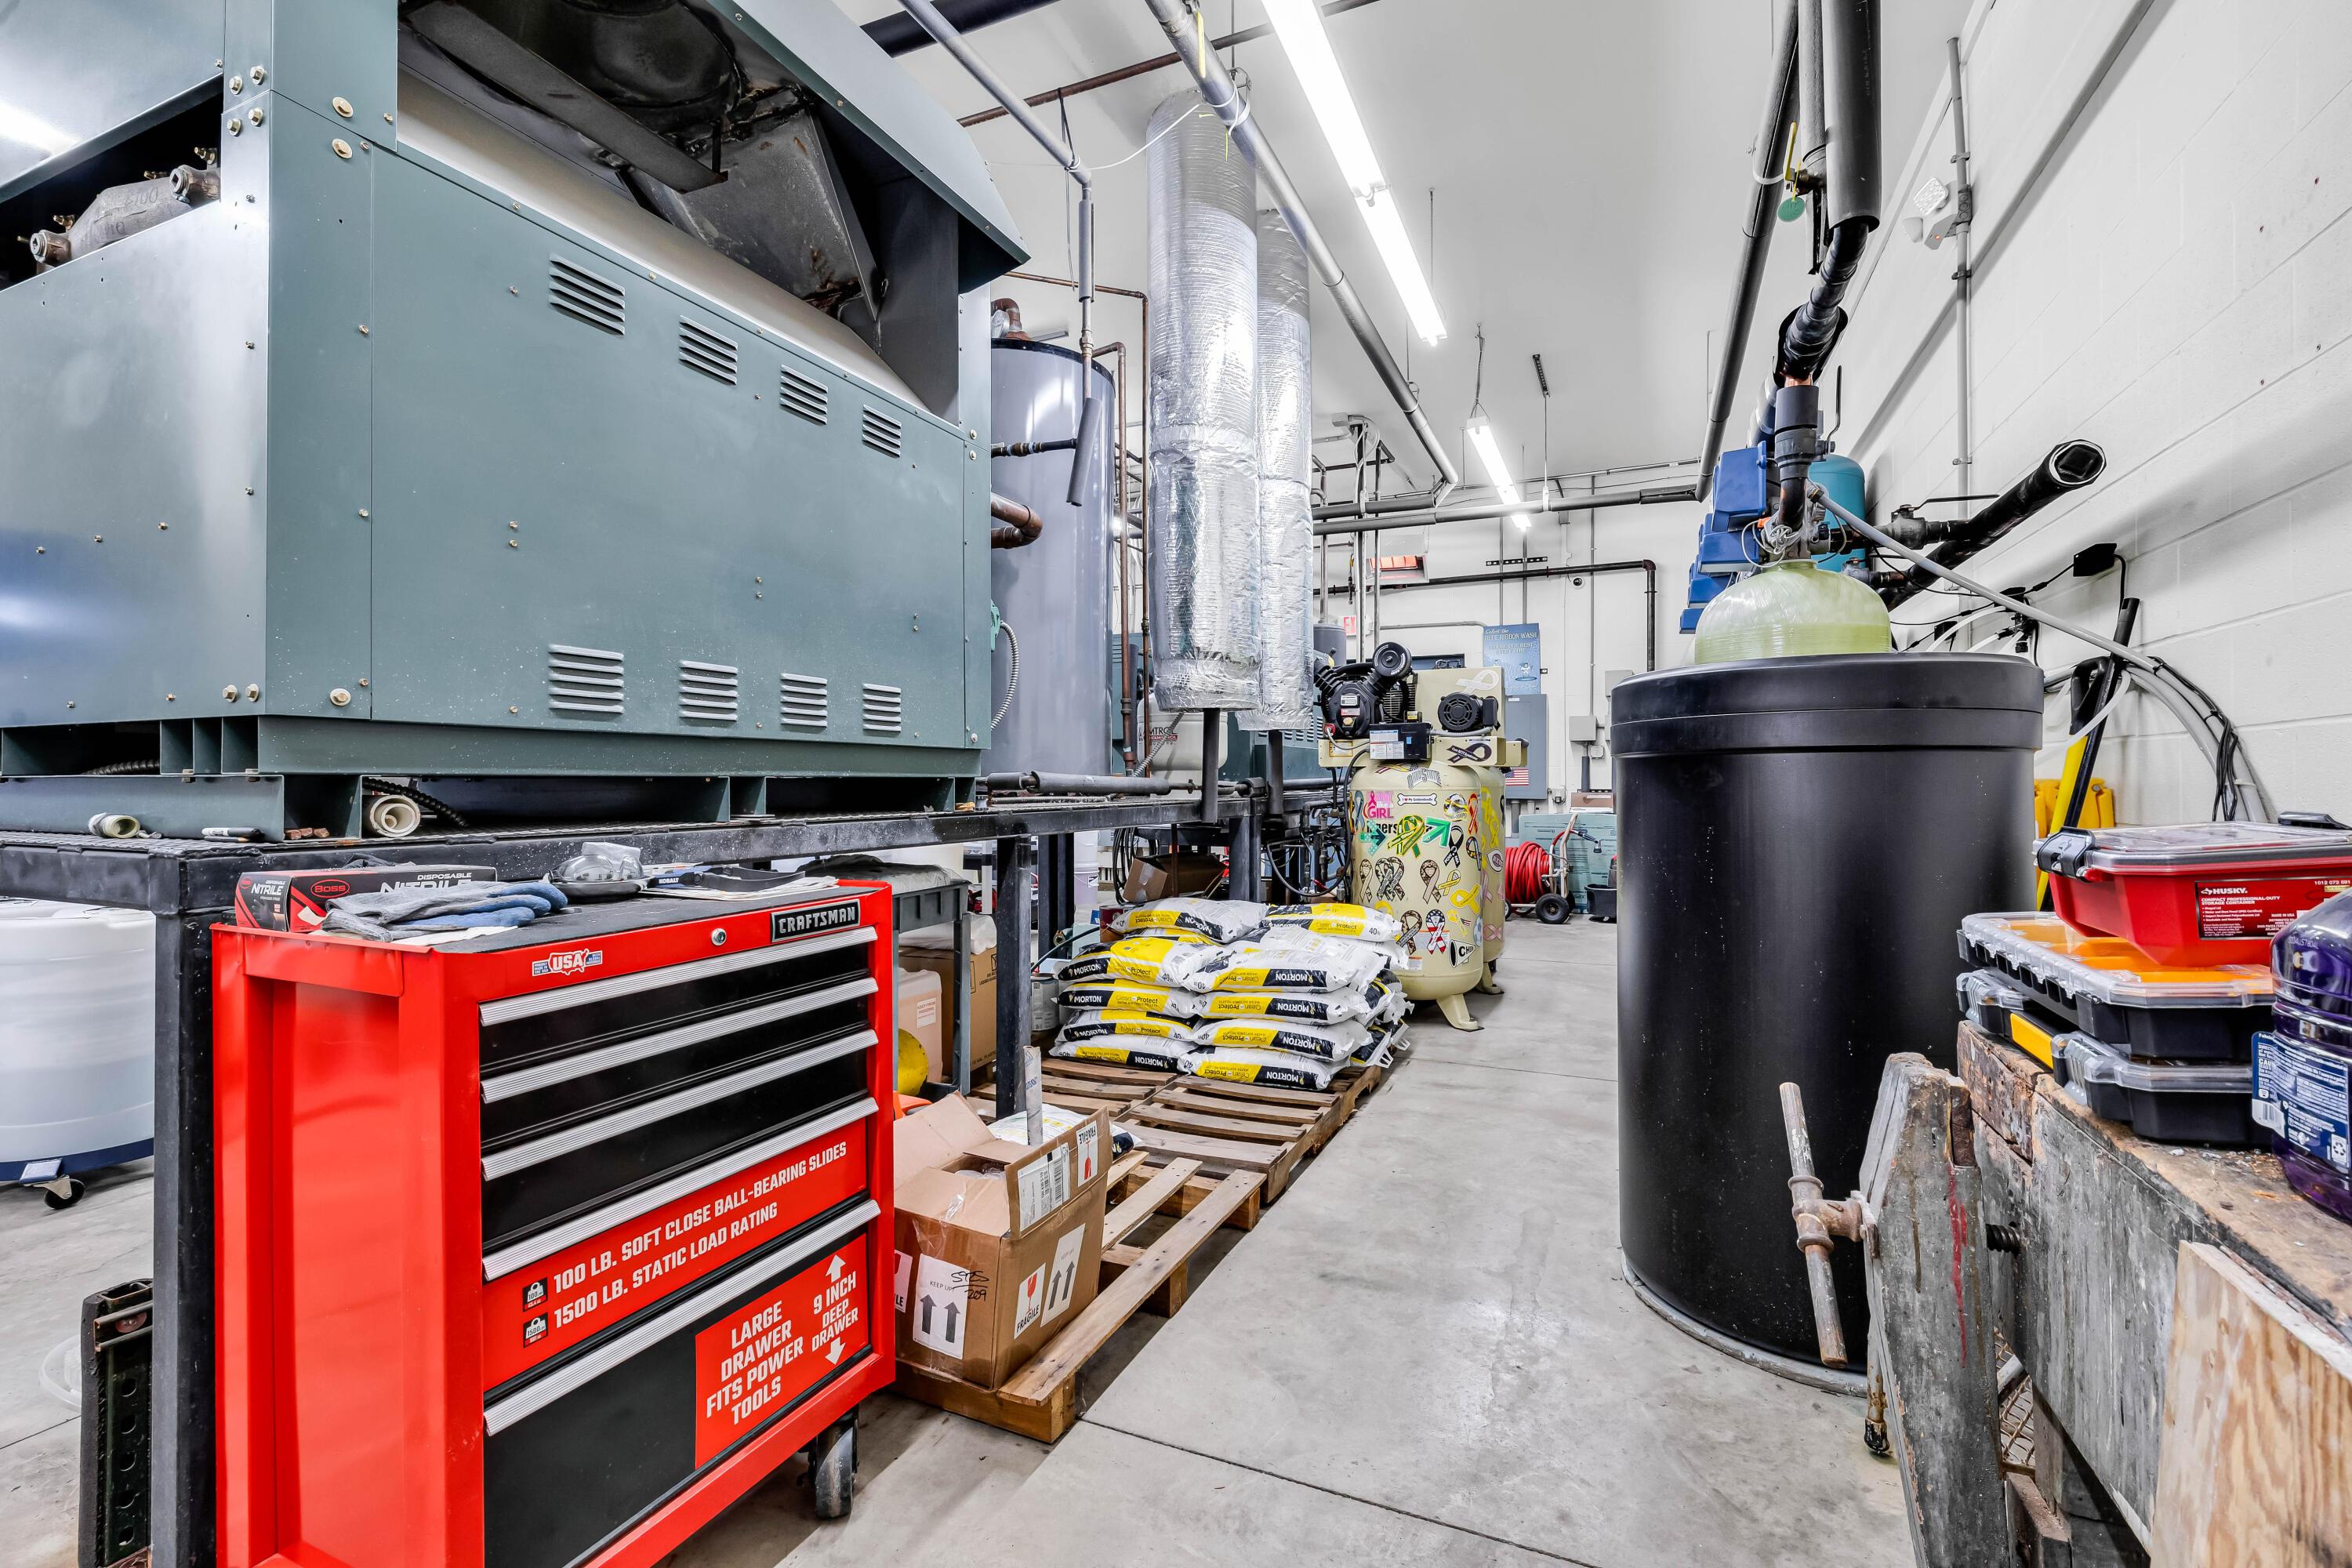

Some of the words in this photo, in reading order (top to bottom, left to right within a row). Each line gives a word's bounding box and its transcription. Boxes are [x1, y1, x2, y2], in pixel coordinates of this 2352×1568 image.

[1367, 805, 1394, 819] GIRL
[417, 873, 472, 881] DISPOSABLE
[251, 883, 284, 895] NITRILE
[779, 906, 855, 934] CRAFTSMAN
[553, 953, 584, 971] USA
[1073, 964, 1101, 976] MORTON
[1276, 972, 1308, 981] MORTON
[1073, 995, 1102, 1004] MORTON
[1277, 1003, 1309, 1013] MORTON
[1283, 1036, 1316, 1051] MORTON
[1134, 1056, 1163, 1067] MORTON
[1266, 1071, 1299, 1083] MORTON
[1078, 1125, 1096, 1145] FRAGILE
[554, 1262, 586, 1294] 100
[590, 1250, 617, 1277] LB.
[621, 1226, 662, 1262] SOFT
[665, 1204, 711, 1240] CLOSE
[714, 1160, 806, 1218] BALL-BEARING
[808, 1141, 847, 1172] SLIDES
[554, 1290, 597, 1329] 1500
[602, 1278, 628, 1305] LB.
[632, 1247, 687, 1289] STATIC
[690, 1226, 728, 1261] LOAD
[730, 1202, 778, 1239] RATING
[930, 1279, 943, 1289] KEEP
[528, 1291, 538, 1301] 100
[813, 1294, 822, 1315] 9
[826, 1270, 856, 1308] INCH
[822, 1298, 849, 1329] DEEP
[1016, 1304, 1040, 1333] FRAGILE
[527, 1325, 540, 1337] 1500
[731, 1300, 782, 1349] LARGE
[811, 1307, 858, 1352] DRAWER
[720, 1319, 792, 1383] DRAWER
[706, 1376, 742, 1418] FITS
[746, 1336, 804, 1391] POWER
[731, 1375, 782, 1425] TOOLS
